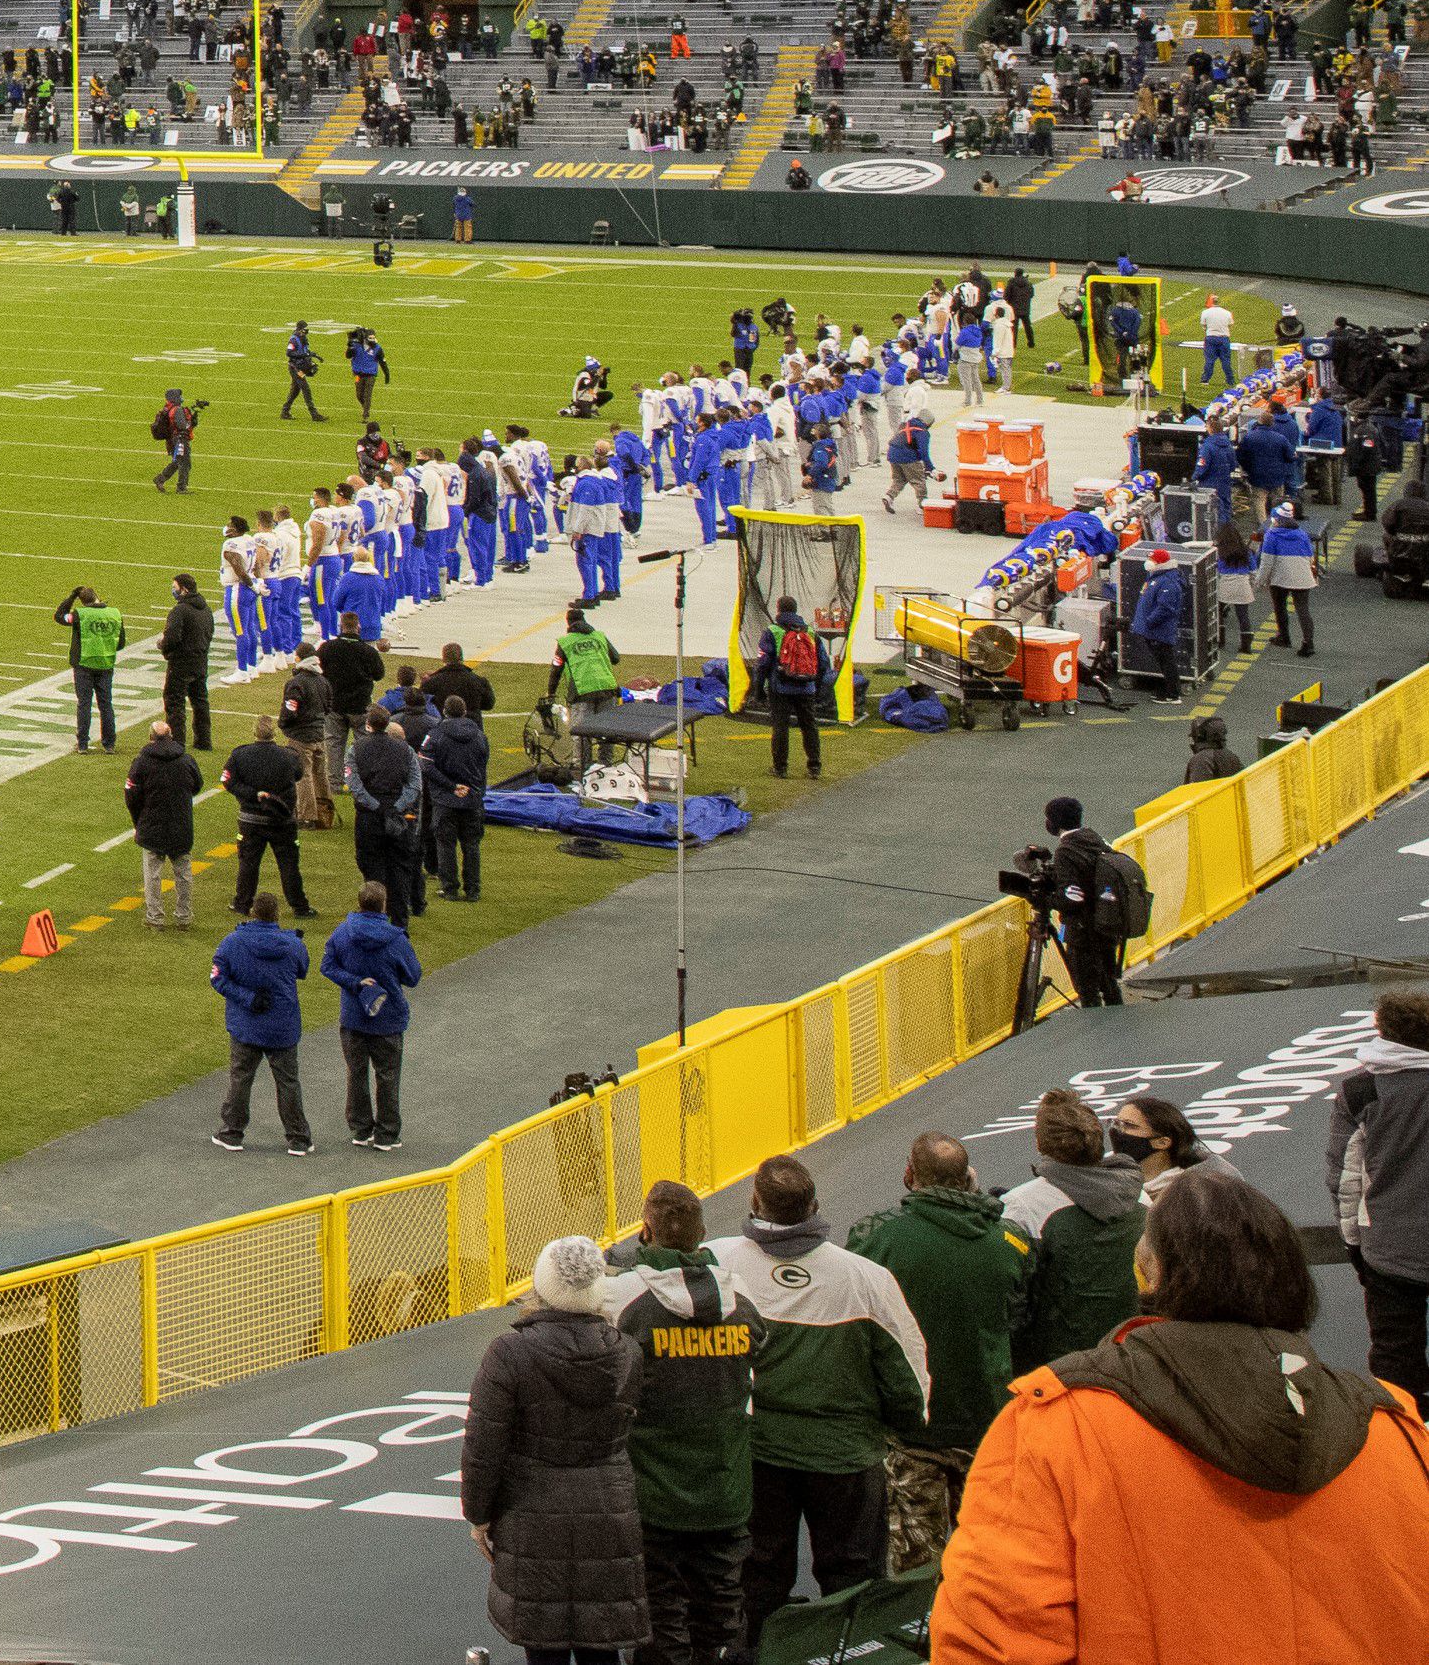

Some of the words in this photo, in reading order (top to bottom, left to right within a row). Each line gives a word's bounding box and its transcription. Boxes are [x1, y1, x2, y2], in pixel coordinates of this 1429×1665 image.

[378, 160, 530, 179] PACKERS
[533, 161, 655, 180] UNITED
[35, 912, 58, 951] 10
[652, 1323, 752, 1359] PACKERS
